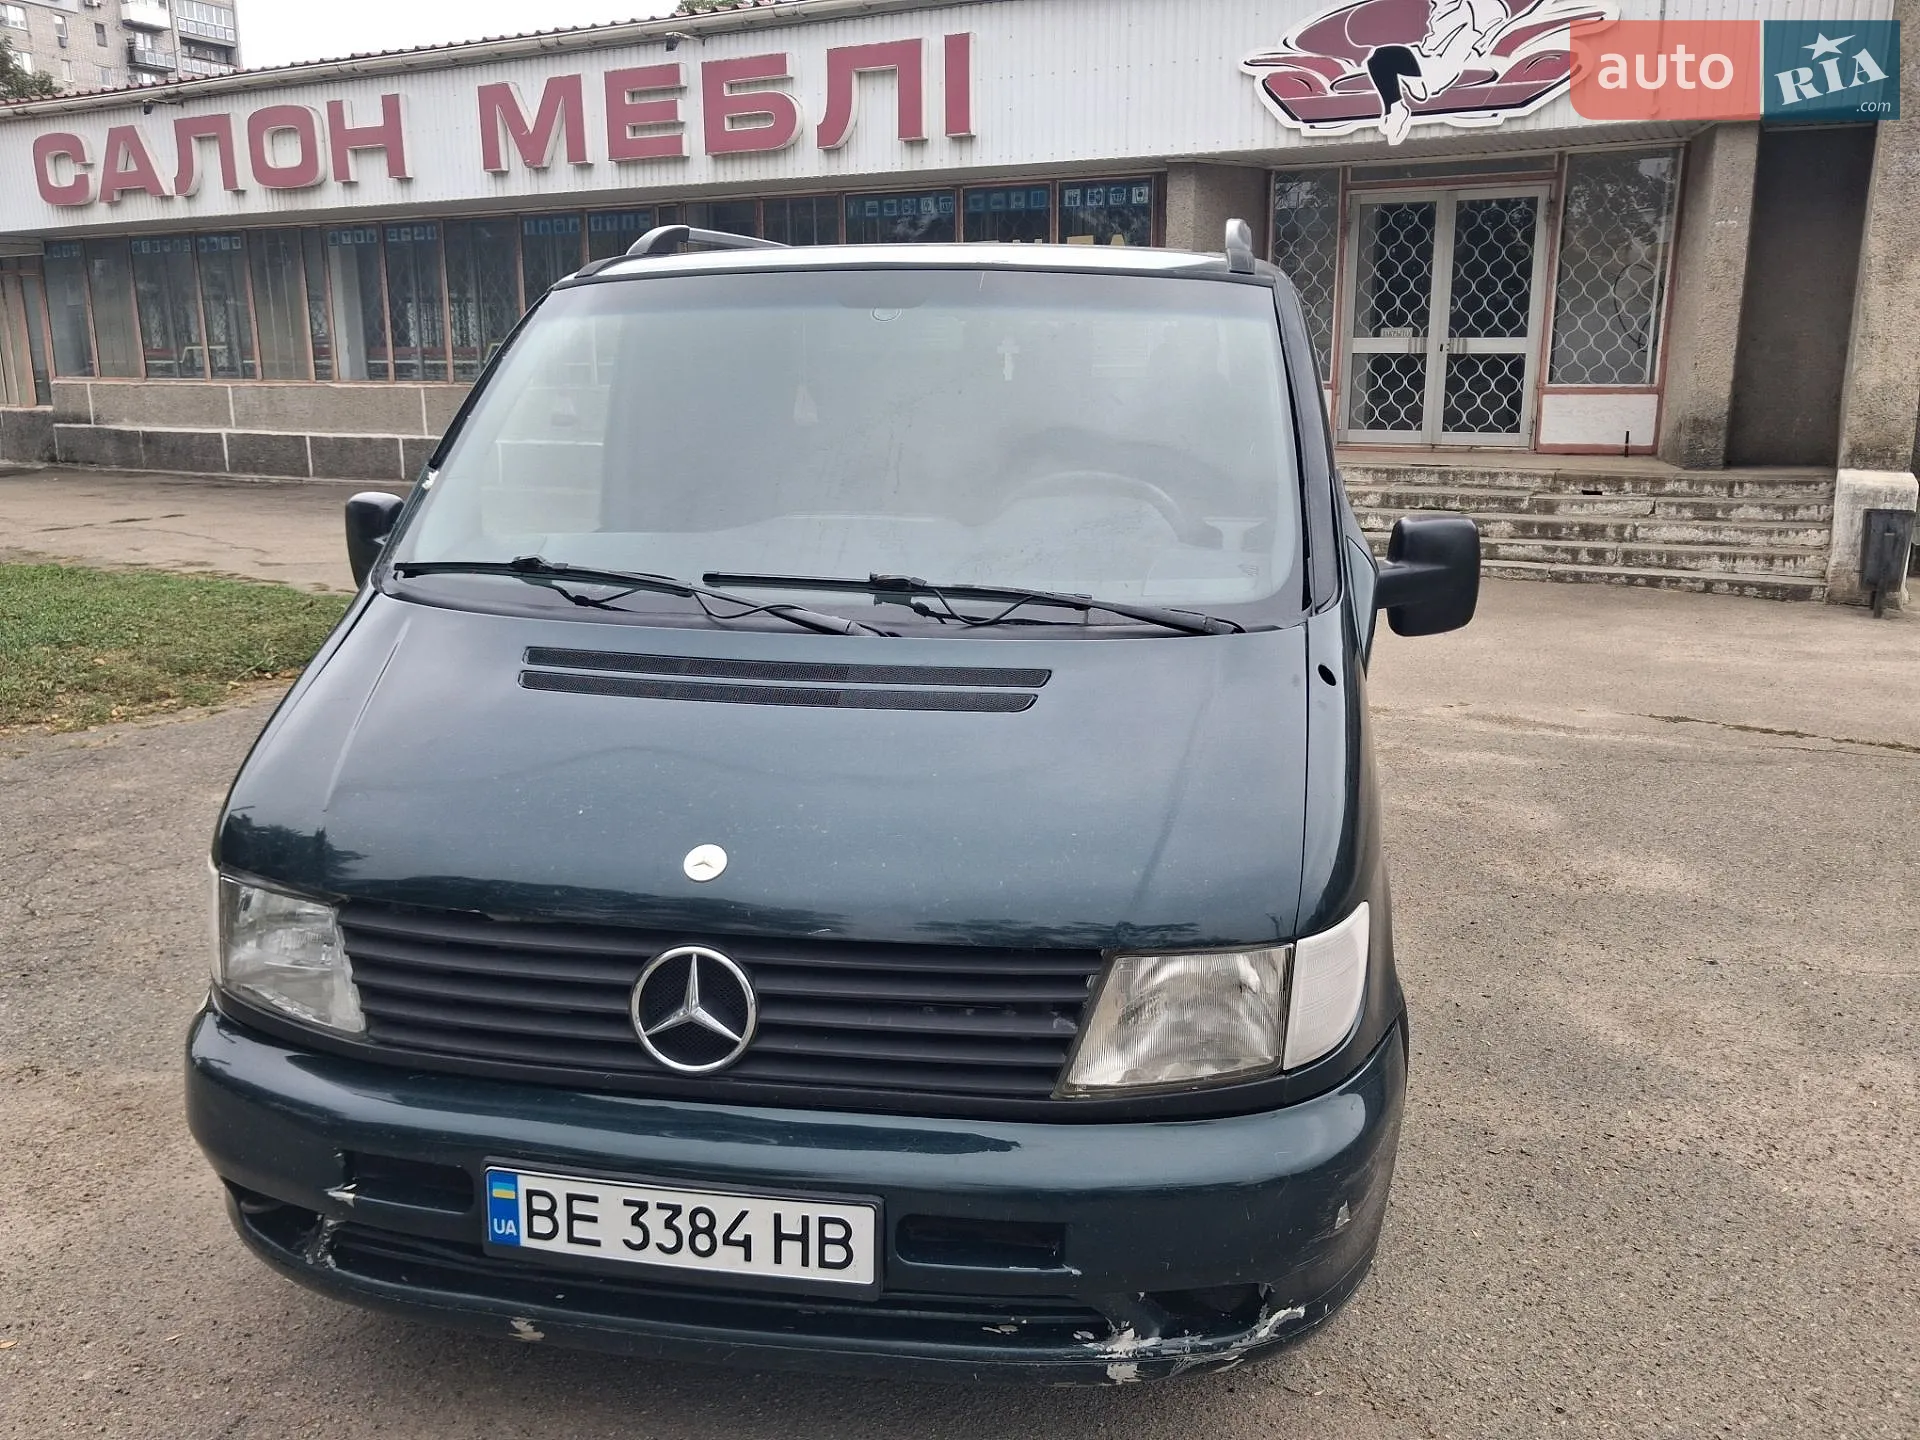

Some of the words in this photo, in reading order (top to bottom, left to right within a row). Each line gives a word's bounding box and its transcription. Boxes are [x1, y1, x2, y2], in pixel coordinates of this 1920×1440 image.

[33, 94, 413, 206] САЛОН
[477, 32, 977, 172] МЕБЛІ
[493, 1218, 517, 1236] UA
[525, 1188, 601, 1247] BE
[622, 1199, 752, 1263] 3384
[773, 1213, 854, 1270] HB
